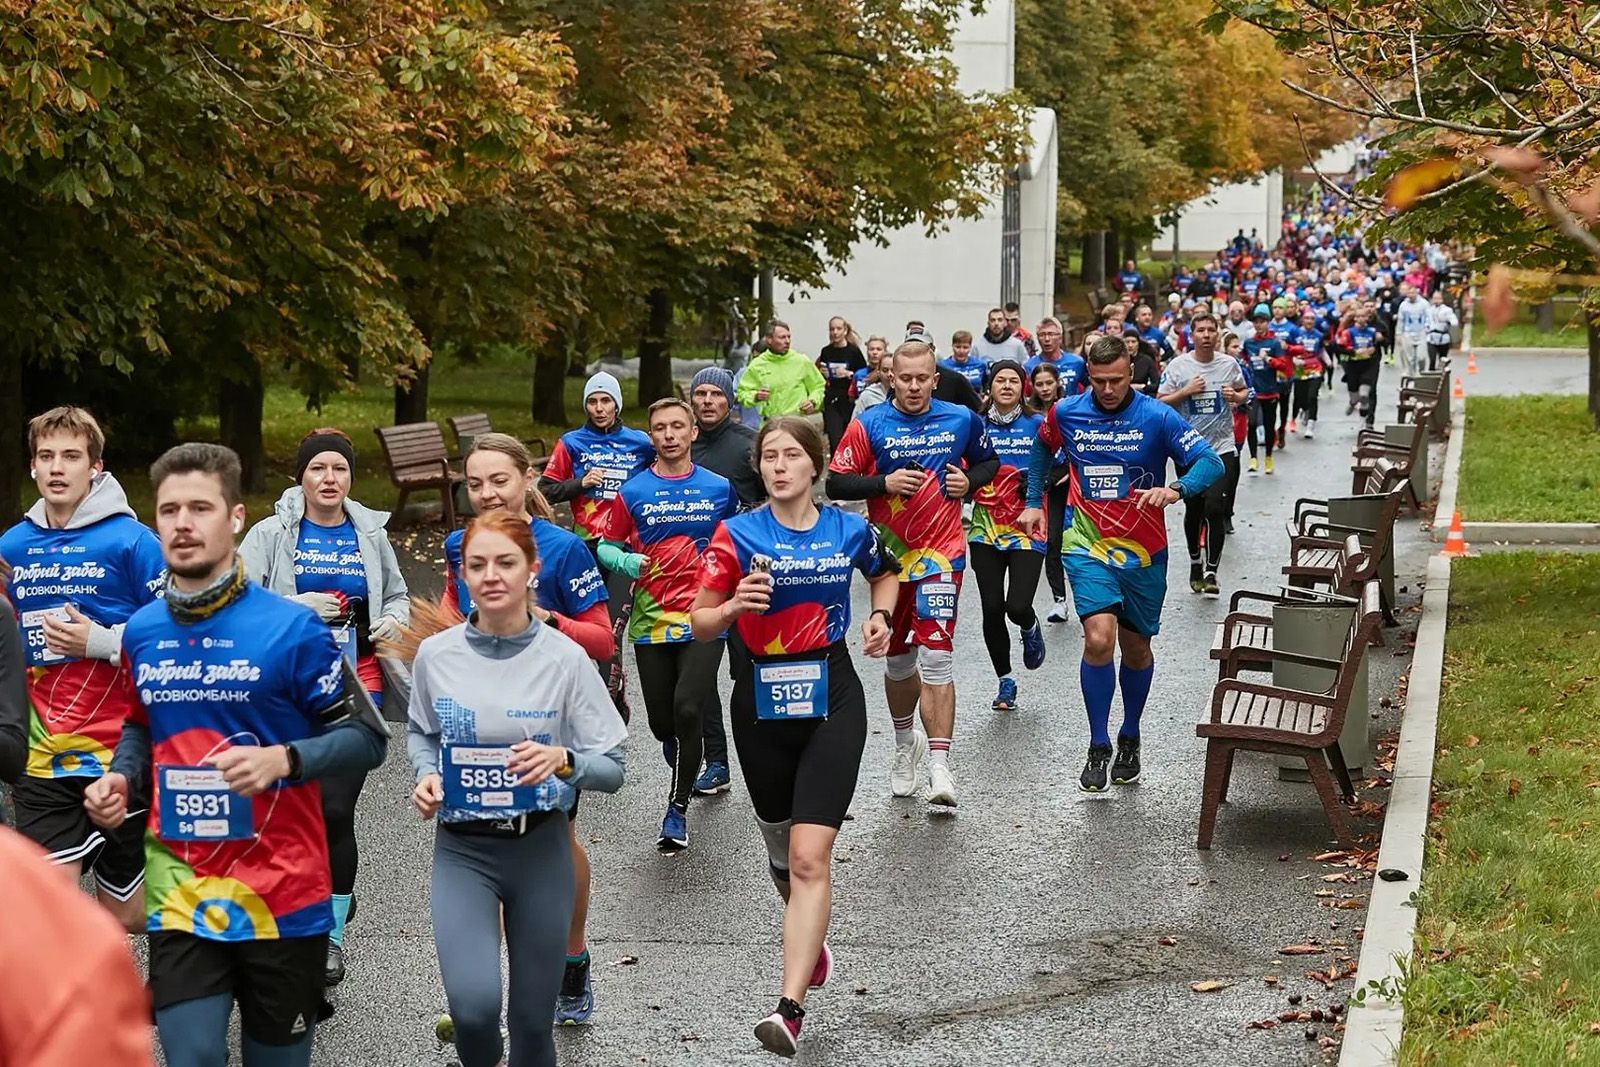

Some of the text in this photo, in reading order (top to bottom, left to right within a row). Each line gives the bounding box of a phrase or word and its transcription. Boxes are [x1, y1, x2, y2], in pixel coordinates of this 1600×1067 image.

[883, 431, 956, 450] Добрый забег
[1073, 428, 1144, 442] Добрый забег
[899, 447, 952, 458] СОВКОМБАНК
[1085, 444, 1139, 452] СОВКОМБАНК
[1089, 476, 1119, 488] 5752
[640, 499, 715, 516] Добрый забег
[655, 514, 711, 524] СОВКОМБАНК
[770, 553, 851, 573] обрый забег
[13, 561, 106, 584] Добрый забег
[776, 573, 848, 586] СОВКОМБАНК
[26, 585, 98, 596] СОВКОМБАНК
[928, 595, 955, 607] 5618
[28, 630, 46, 647] 55
[136, 659, 261, 687] Добрый забег
[153, 688, 250, 703] СОВКОМБАНК
[771, 682, 814, 701] 5137
[460, 768, 518, 788] 5839
[175, 794, 230, 816] 5931
